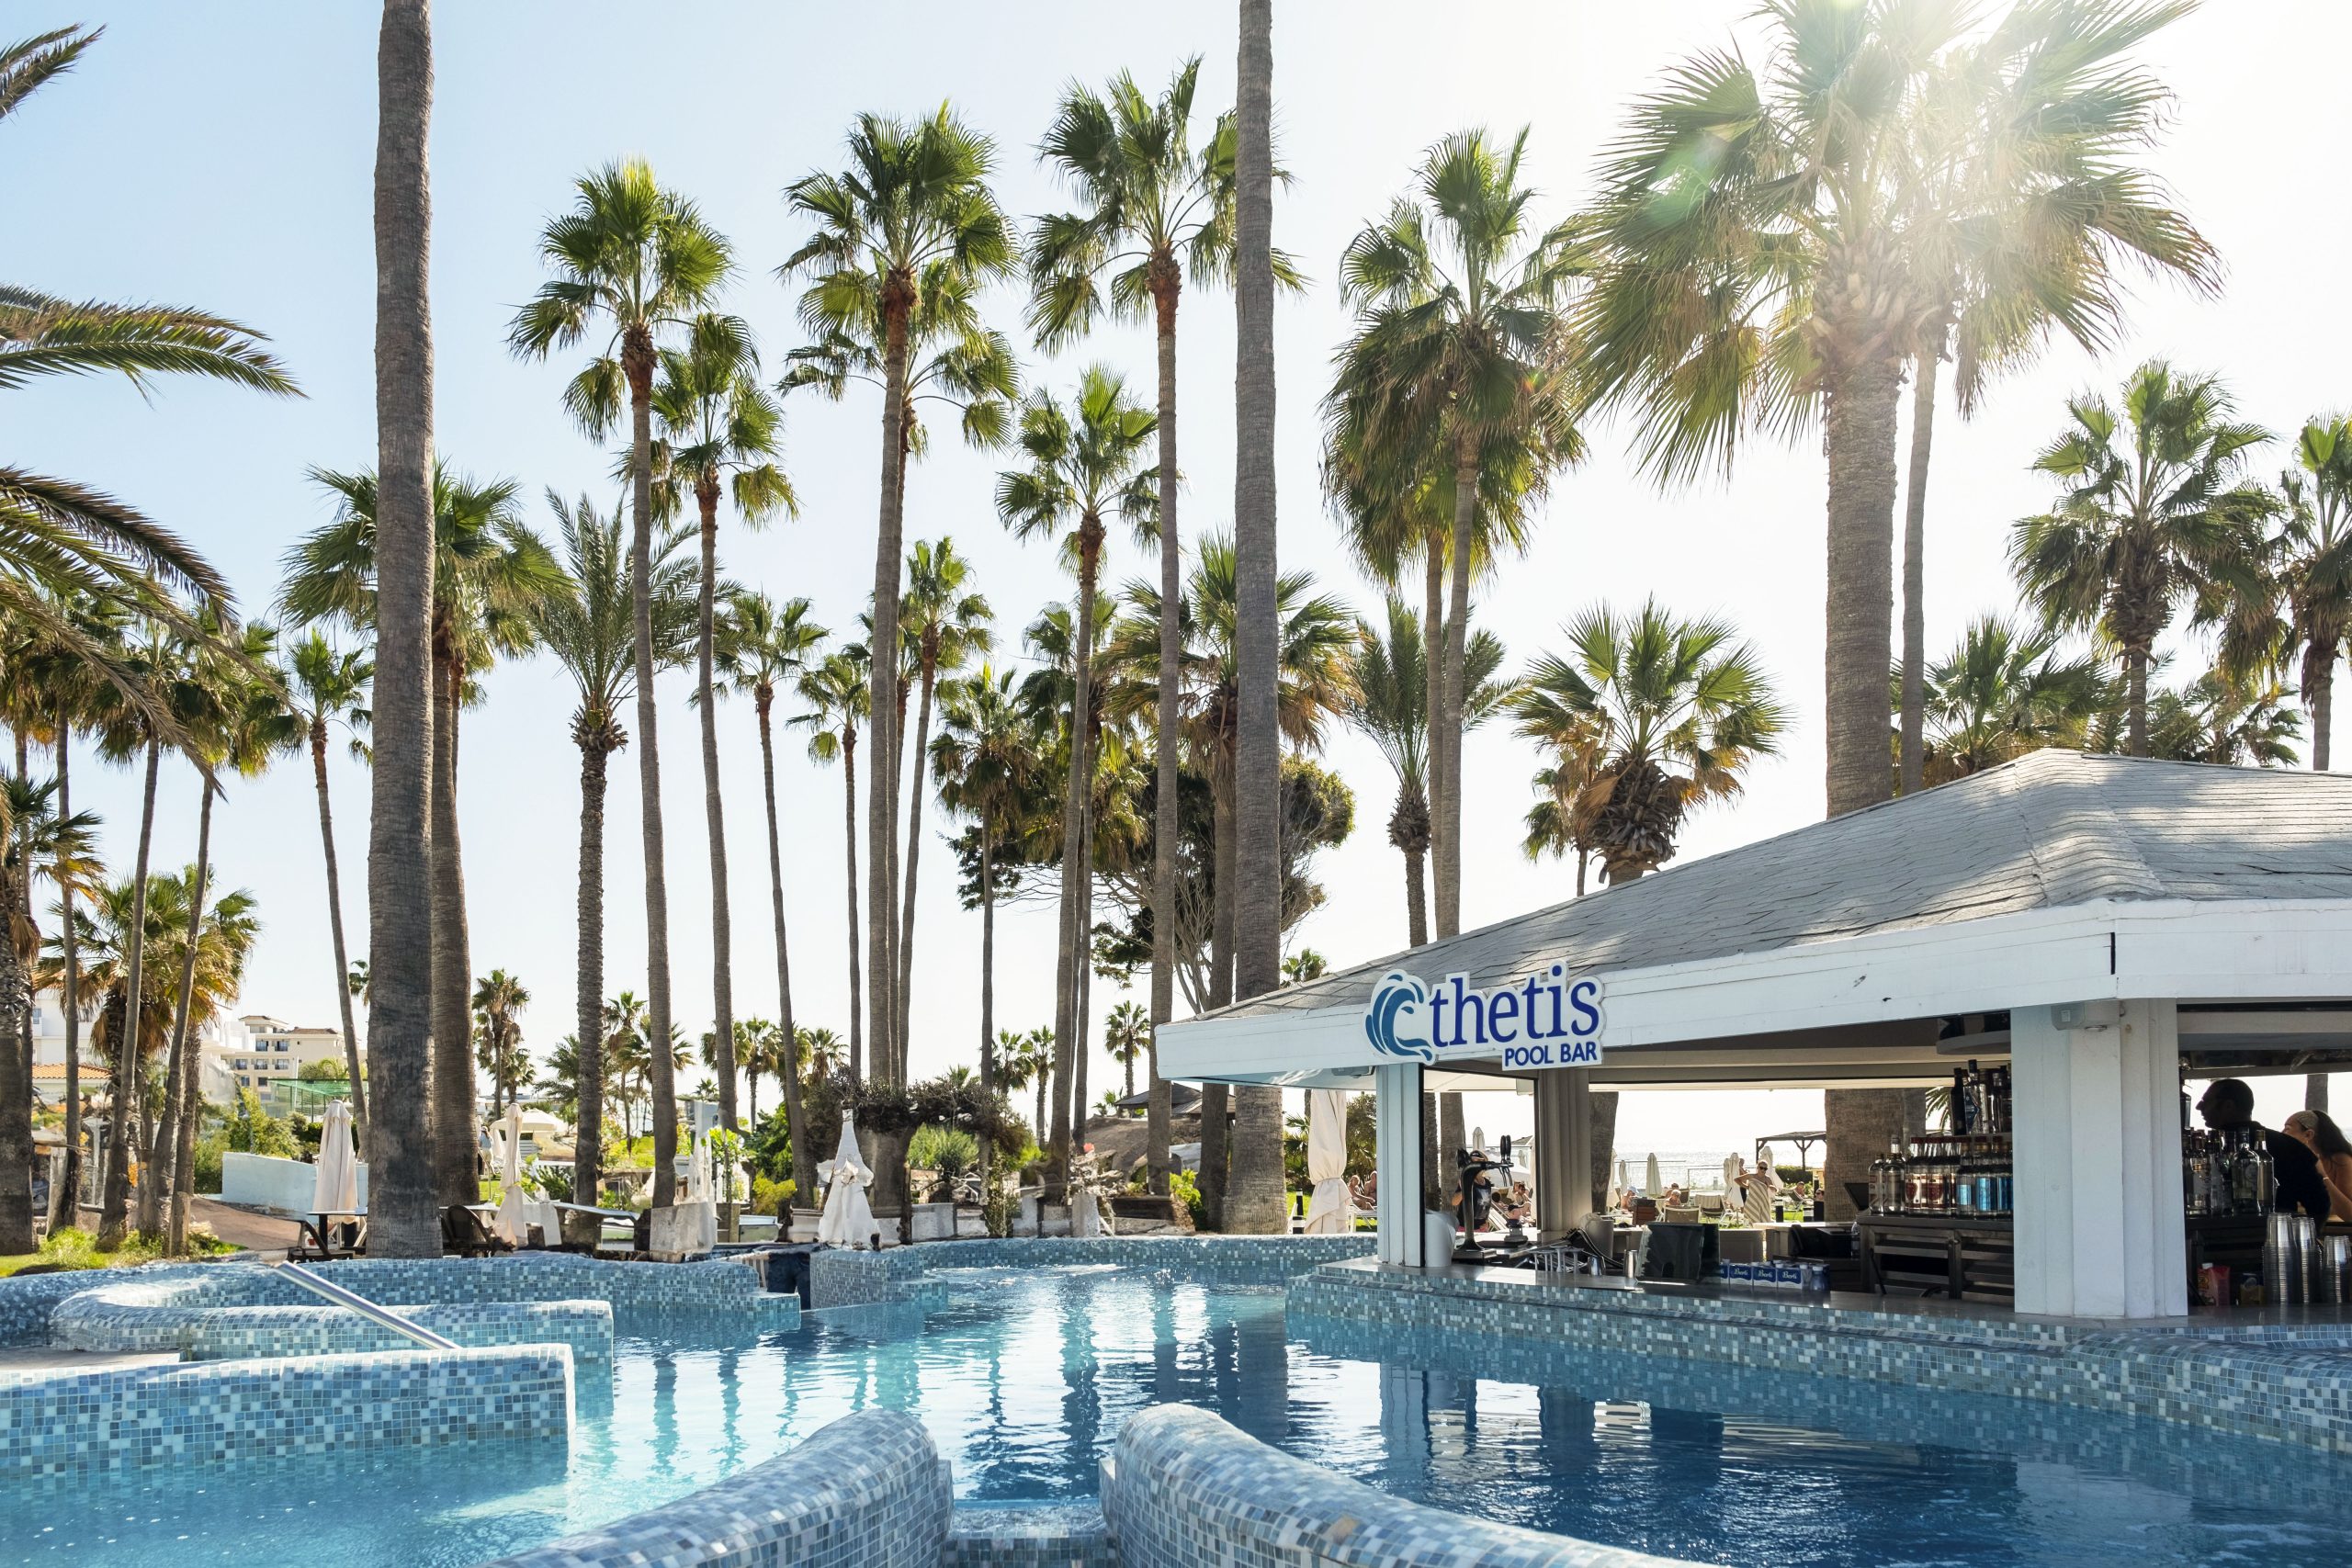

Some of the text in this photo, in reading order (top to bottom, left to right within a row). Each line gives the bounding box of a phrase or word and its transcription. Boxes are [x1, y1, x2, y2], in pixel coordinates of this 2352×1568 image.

[1429, 964, 1600, 1047] thetis
[1504, 1041, 1598, 1066] POOL BAR
